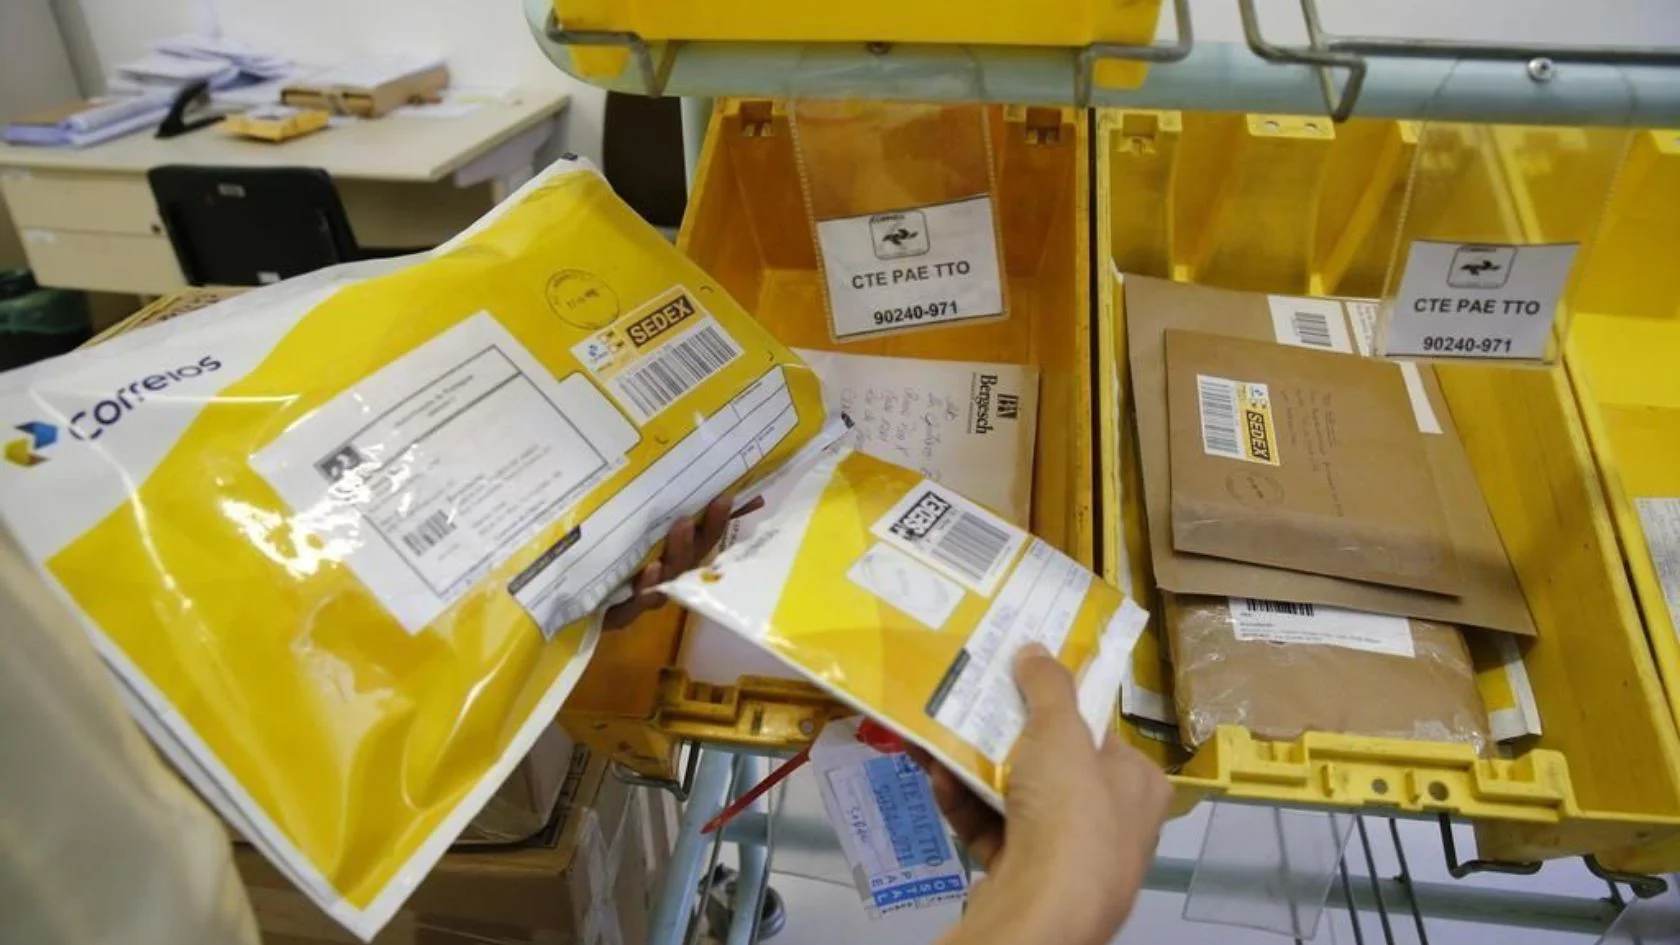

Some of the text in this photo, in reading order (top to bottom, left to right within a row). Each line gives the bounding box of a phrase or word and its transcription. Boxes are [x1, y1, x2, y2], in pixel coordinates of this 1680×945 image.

[852, 260, 971, 290] CTE PAE TTO
[628, 298, 693, 345] SEDEX
[873, 300, 958, 325] 90240-971
[1414, 298, 1541, 315] CTE PAE TTO
[1423, 336, 1512, 353] 90240-971
[69, 354, 222, 441] Correios
[975, 374, 998, 435] Bergesch
[1248, 412, 1270, 460] SEDEX
